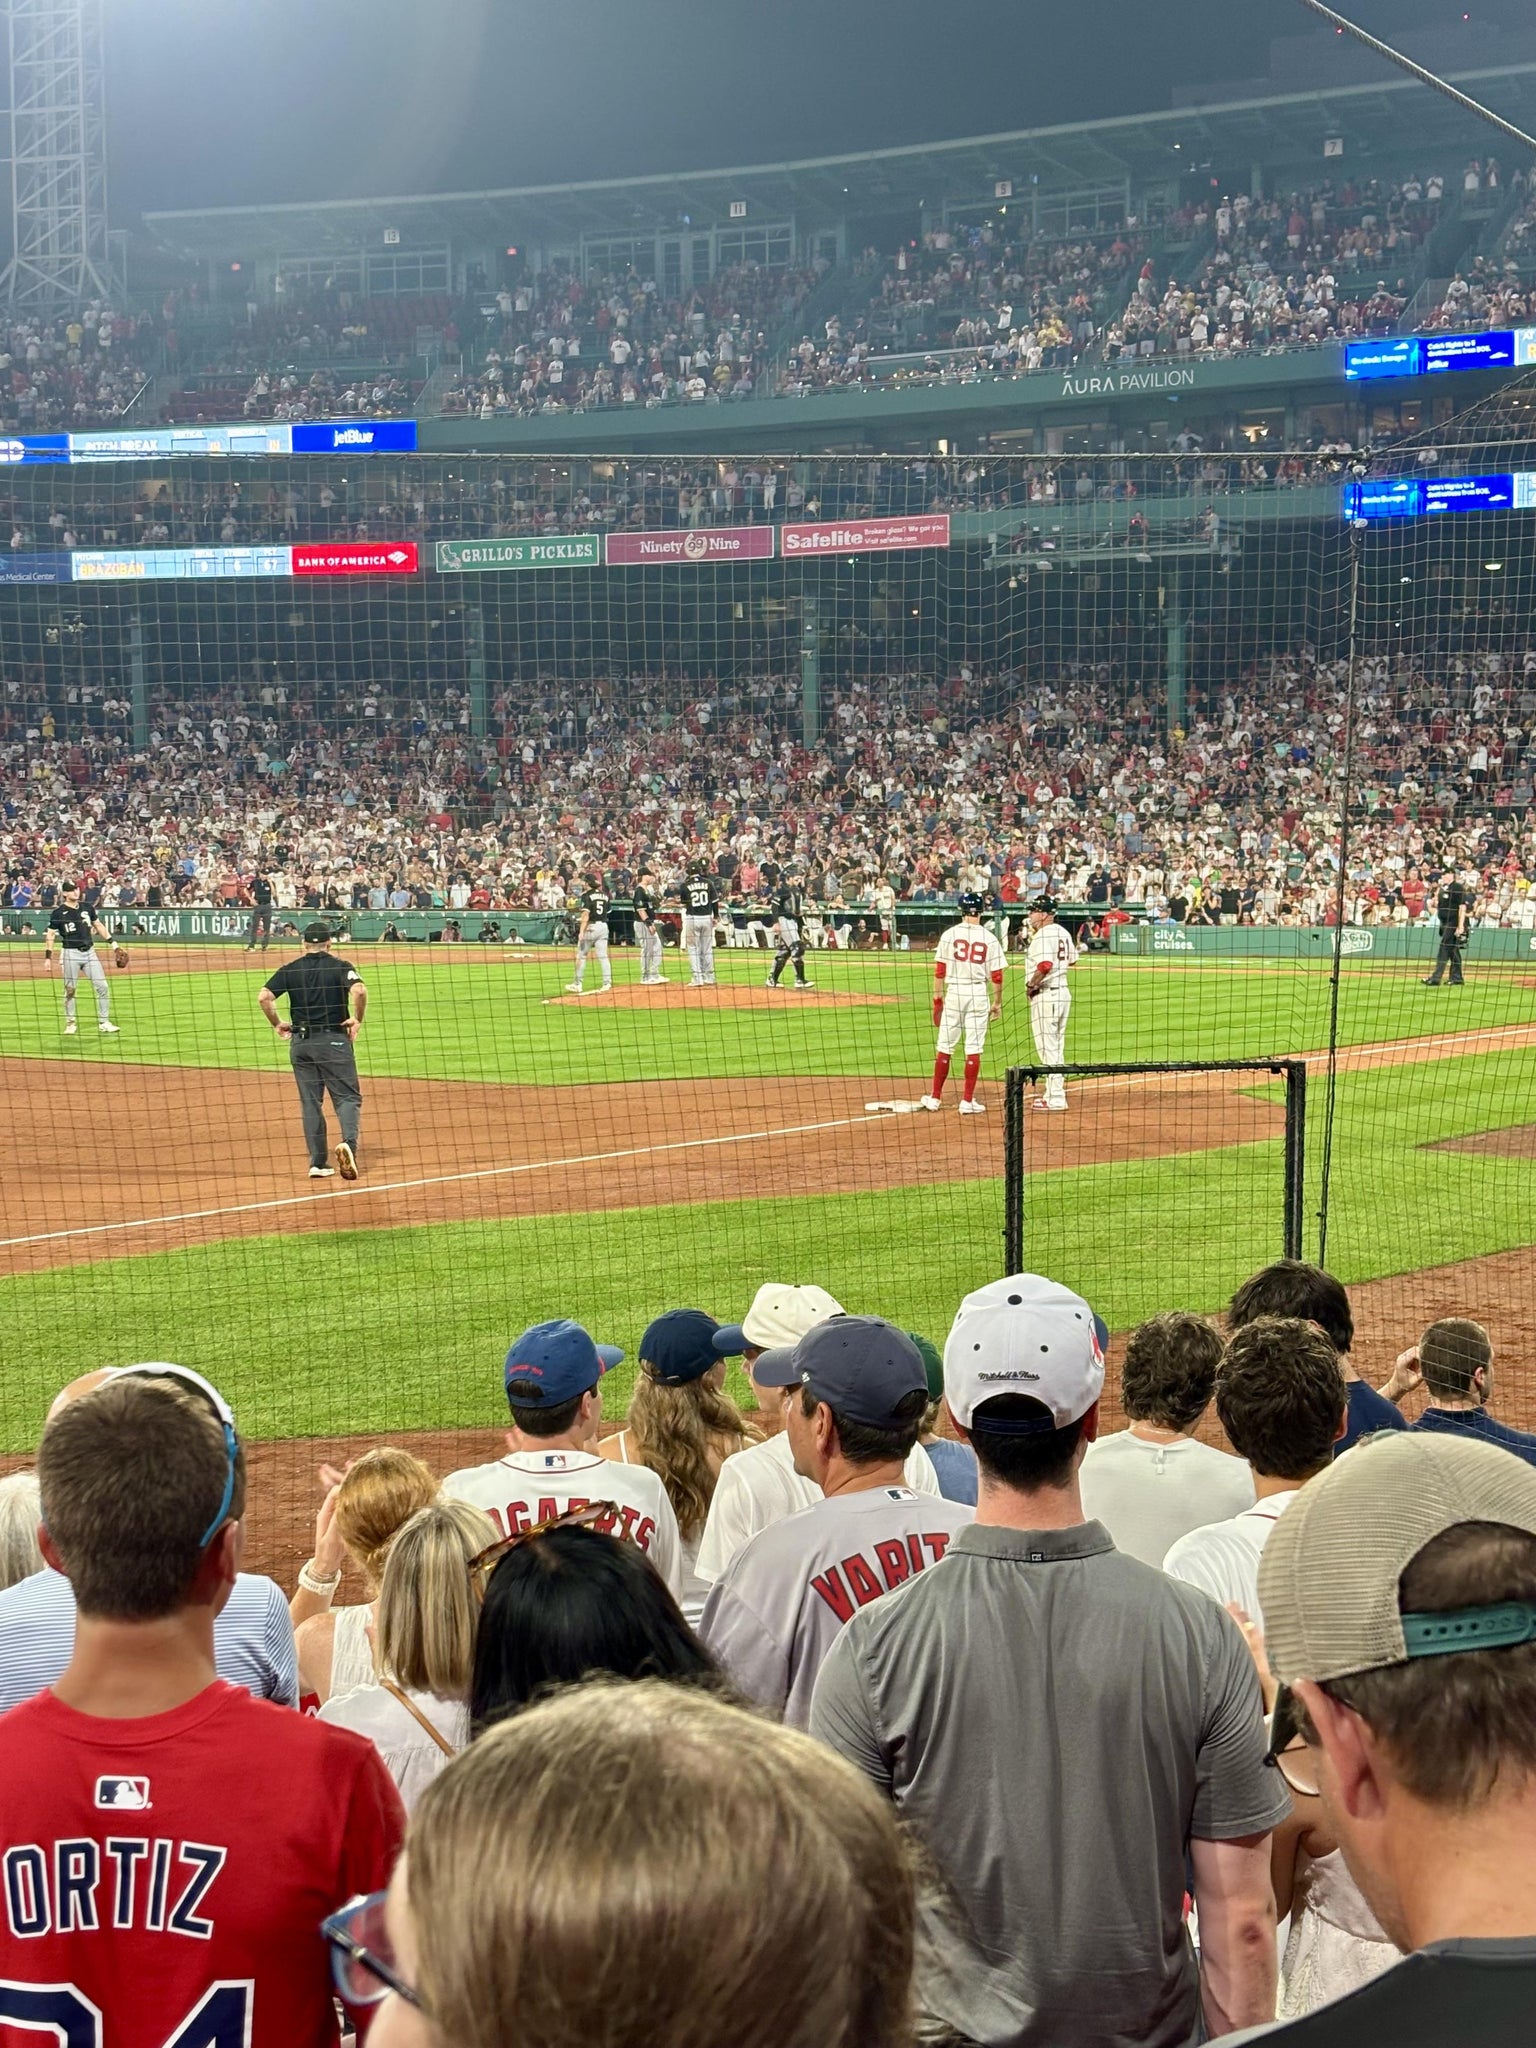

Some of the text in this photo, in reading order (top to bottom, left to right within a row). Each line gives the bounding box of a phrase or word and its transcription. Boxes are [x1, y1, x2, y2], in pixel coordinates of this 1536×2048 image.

[1119, 369, 1194, 391] PAVILION
[119, 439, 159, 451] BREAK
[334, 429, 375, 447] jetBlue
[640, 541, 684, 554] Ninety
[709, 537, 741, 550] Nine
[786, 530, 864, 550] Safelite
[299, 555, 387, 567] BANK OF AMERICA
[461, 544, 593, 562] GRILLO'S PICKLES
[6, 572, 32, 581] Medical
[32, 572, 56, 581] Center
[690, 890, 709, 907] 20
[596, 901, 604, 915] 5
[64, 922, 76, 933] 12
[1154, 930, 1173, 942] city
[953, 939, 988, 964] 38
[1154, 940, 1195, 950] cruises.
[811, 1531, 951, 1624] VARIT
[2, 1836, 228, 1940] ORTIZ
